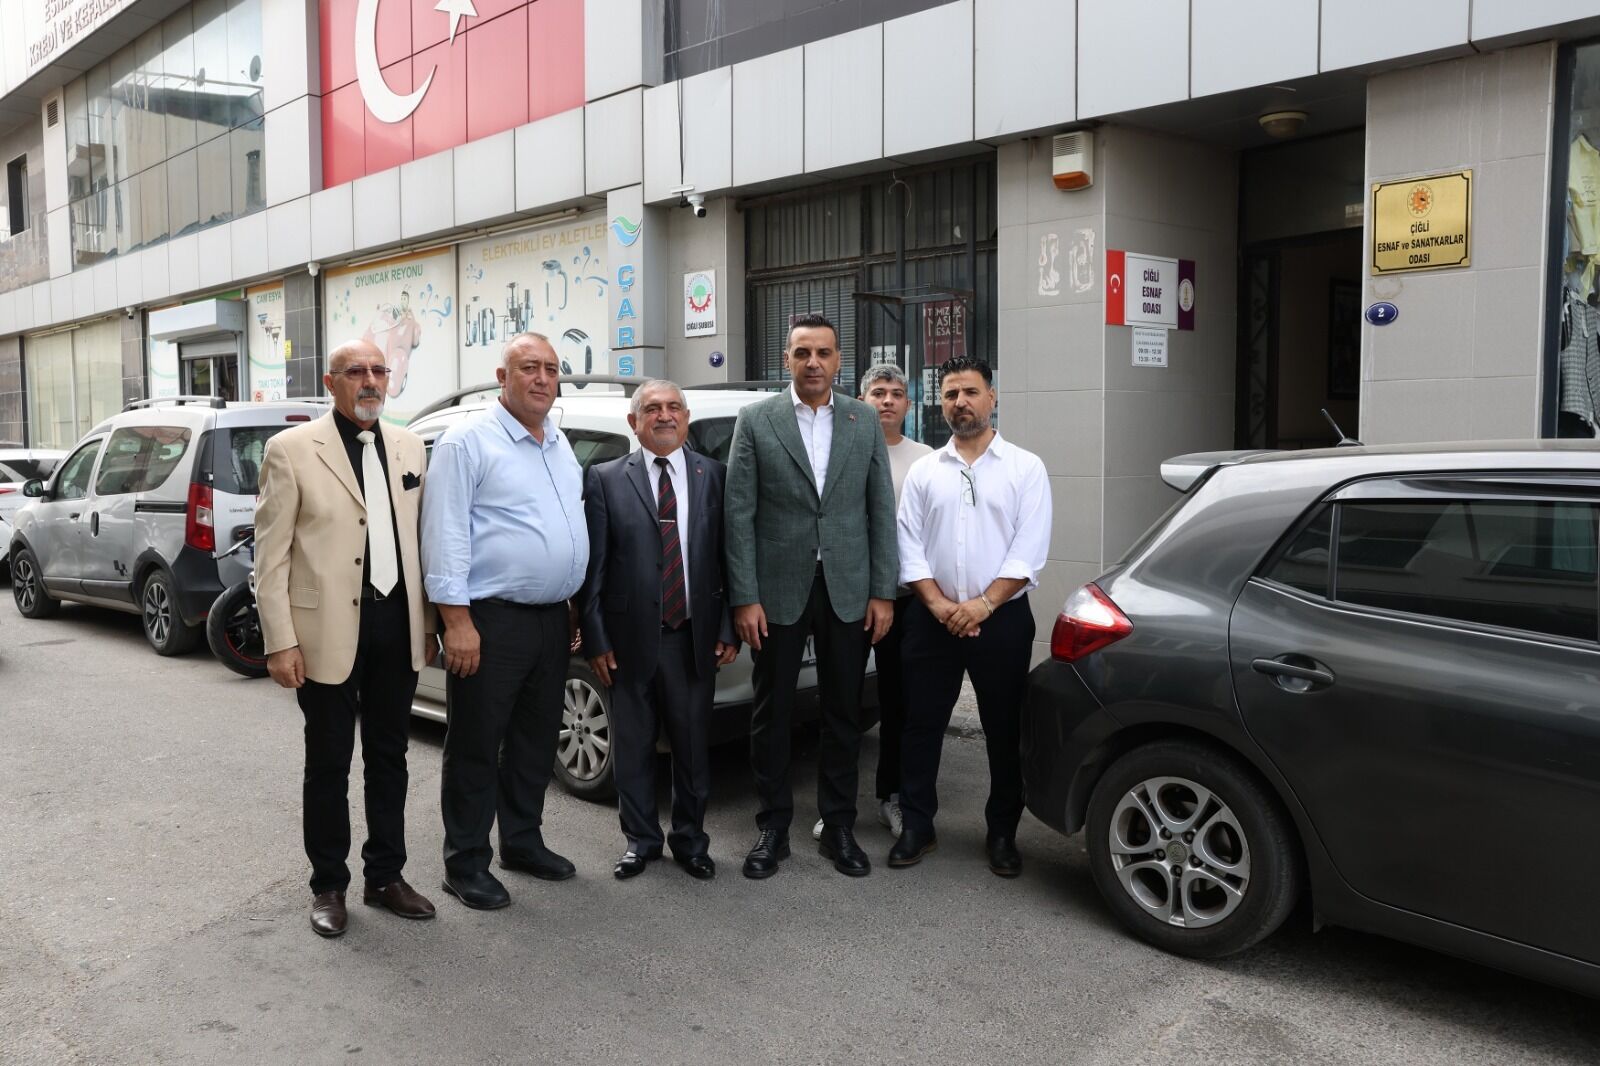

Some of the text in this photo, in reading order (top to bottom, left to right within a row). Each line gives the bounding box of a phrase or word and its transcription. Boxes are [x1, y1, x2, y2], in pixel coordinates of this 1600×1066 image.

[60, 15, 73, 43] VE
[1410, 220, 1430, 236] ÇİĞLİ
[542, 234, 556, 249] EV
[1377, 234, 1464, 252] ESNAF ve SANATKARLAR
[1409, 253, 1430, 265] ODASI
[355, 264, 424, 288] OYUNCAK REYONU
[1143, 268, 1160, 283] ÇİĞLİ
[1142, 286, 1162, 298] ESNAF
[1142, 302, 1161, 315] ODASI
[1378, 307, 1385, 318] 2
